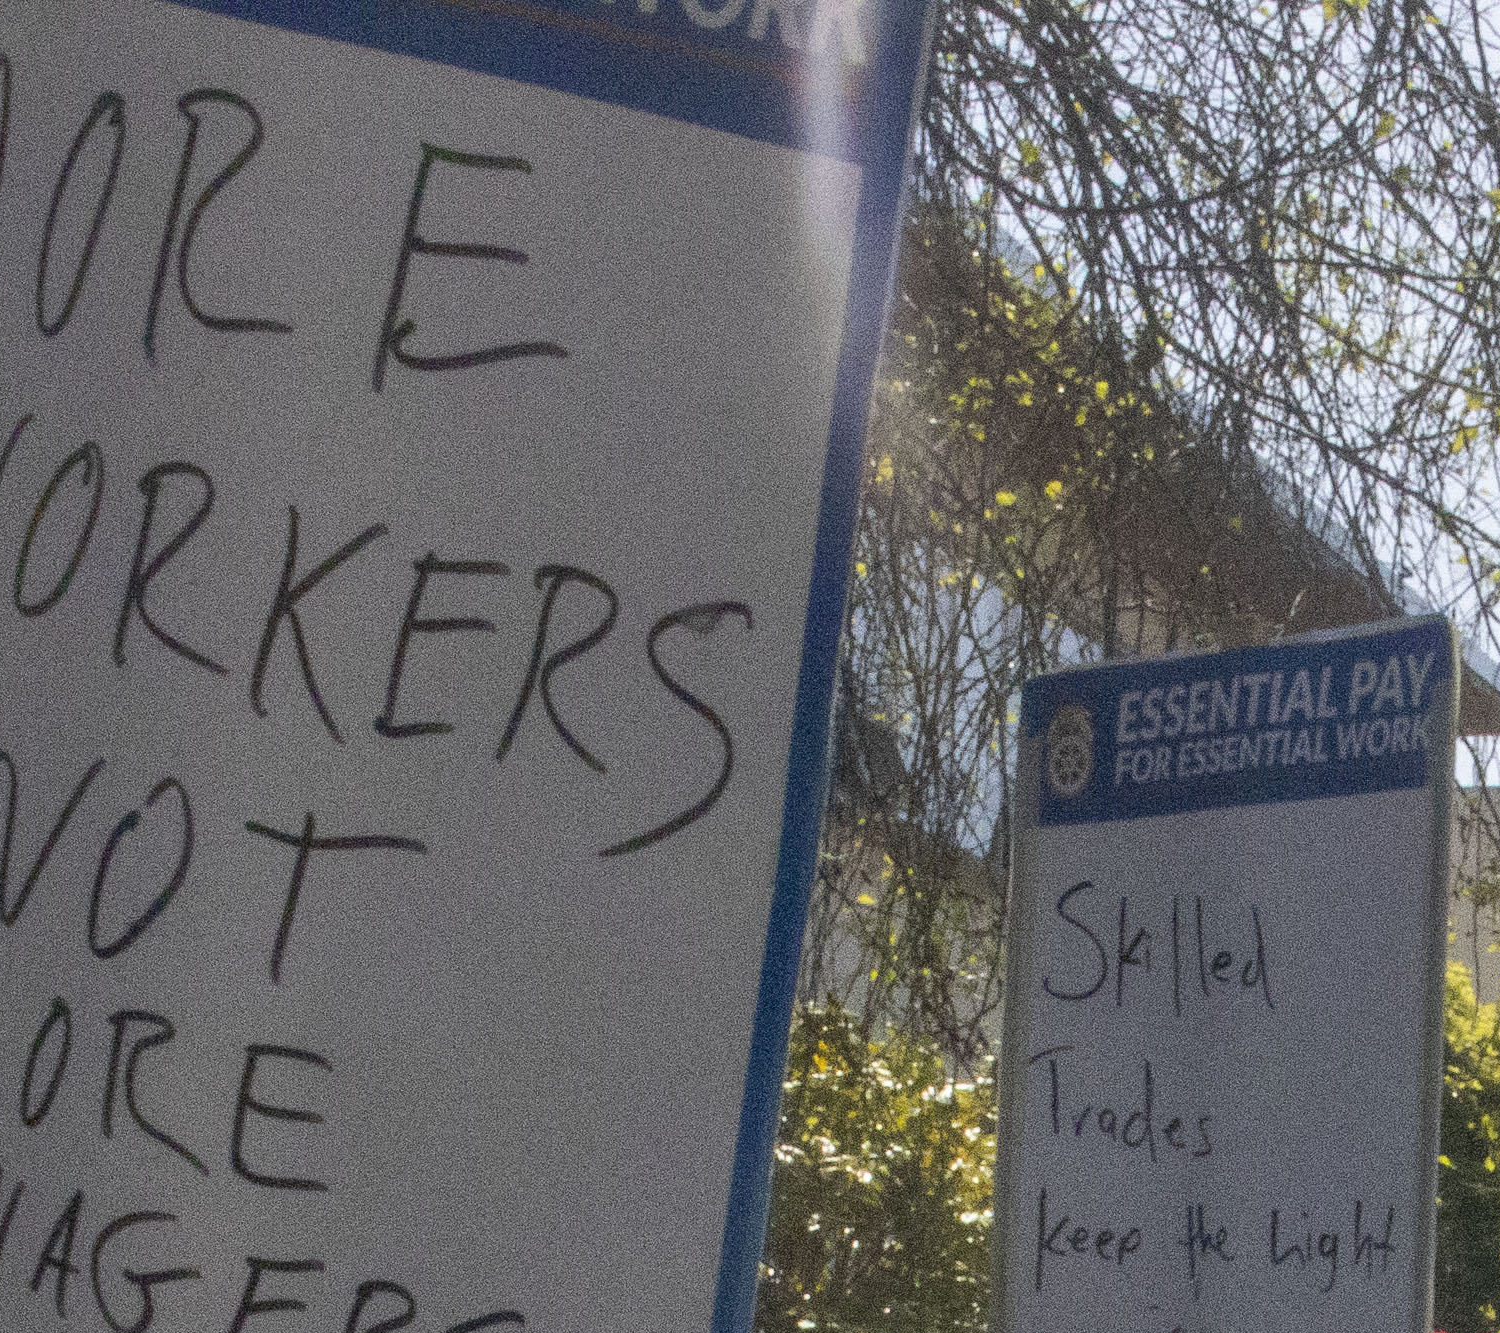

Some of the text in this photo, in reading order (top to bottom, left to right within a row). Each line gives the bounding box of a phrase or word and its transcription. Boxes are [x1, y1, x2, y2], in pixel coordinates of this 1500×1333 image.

[1114, 714, 1432, 786] FOR ESSENTIAL WORK
[1116, 653, 1437, 744] ESSENTIAL PAY
[1042, 879, 1276, 1017] Skilled
[1028, 1044, 1213, 1163] Trades
